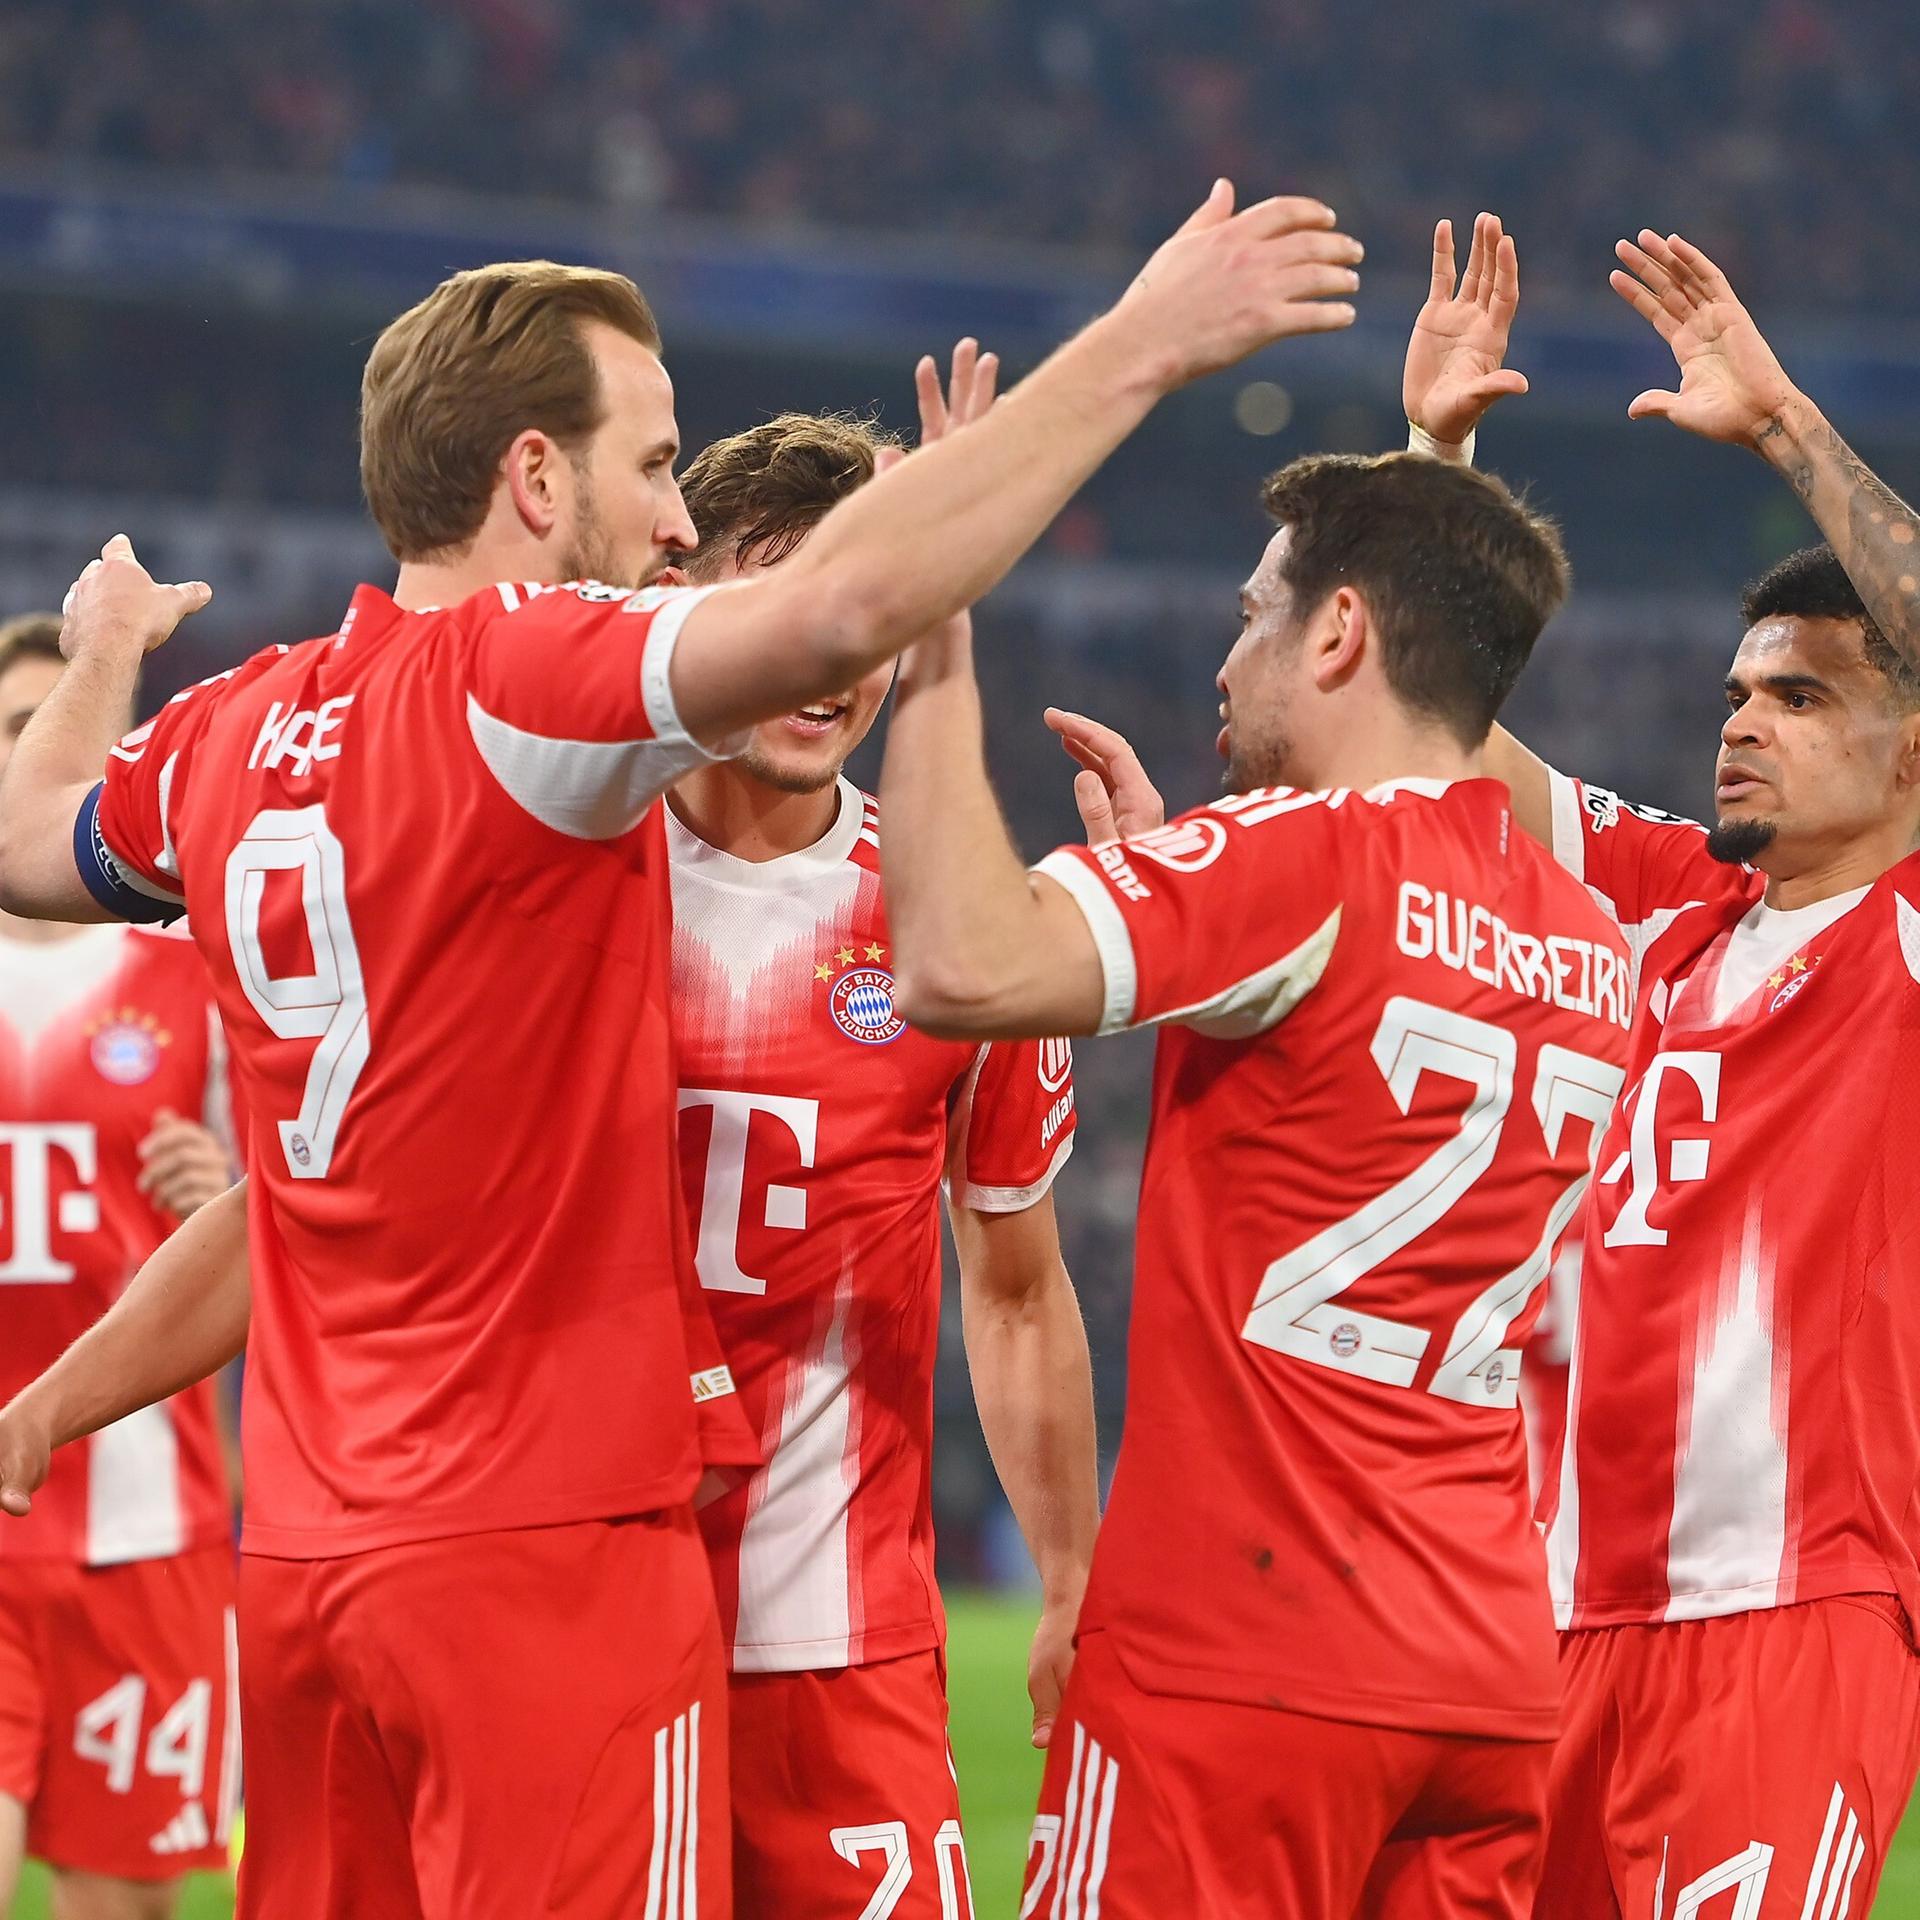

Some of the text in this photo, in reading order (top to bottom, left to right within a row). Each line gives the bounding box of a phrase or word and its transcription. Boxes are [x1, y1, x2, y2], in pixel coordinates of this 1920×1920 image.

[247, 694, 356, 777] KAE
[224, 803, 371, 1179] 9
[837, 973, 896, 1000] FC BAYER
[1241, 995, 1627, 1409] 22
[73, 1673, 212, 1798] 44
